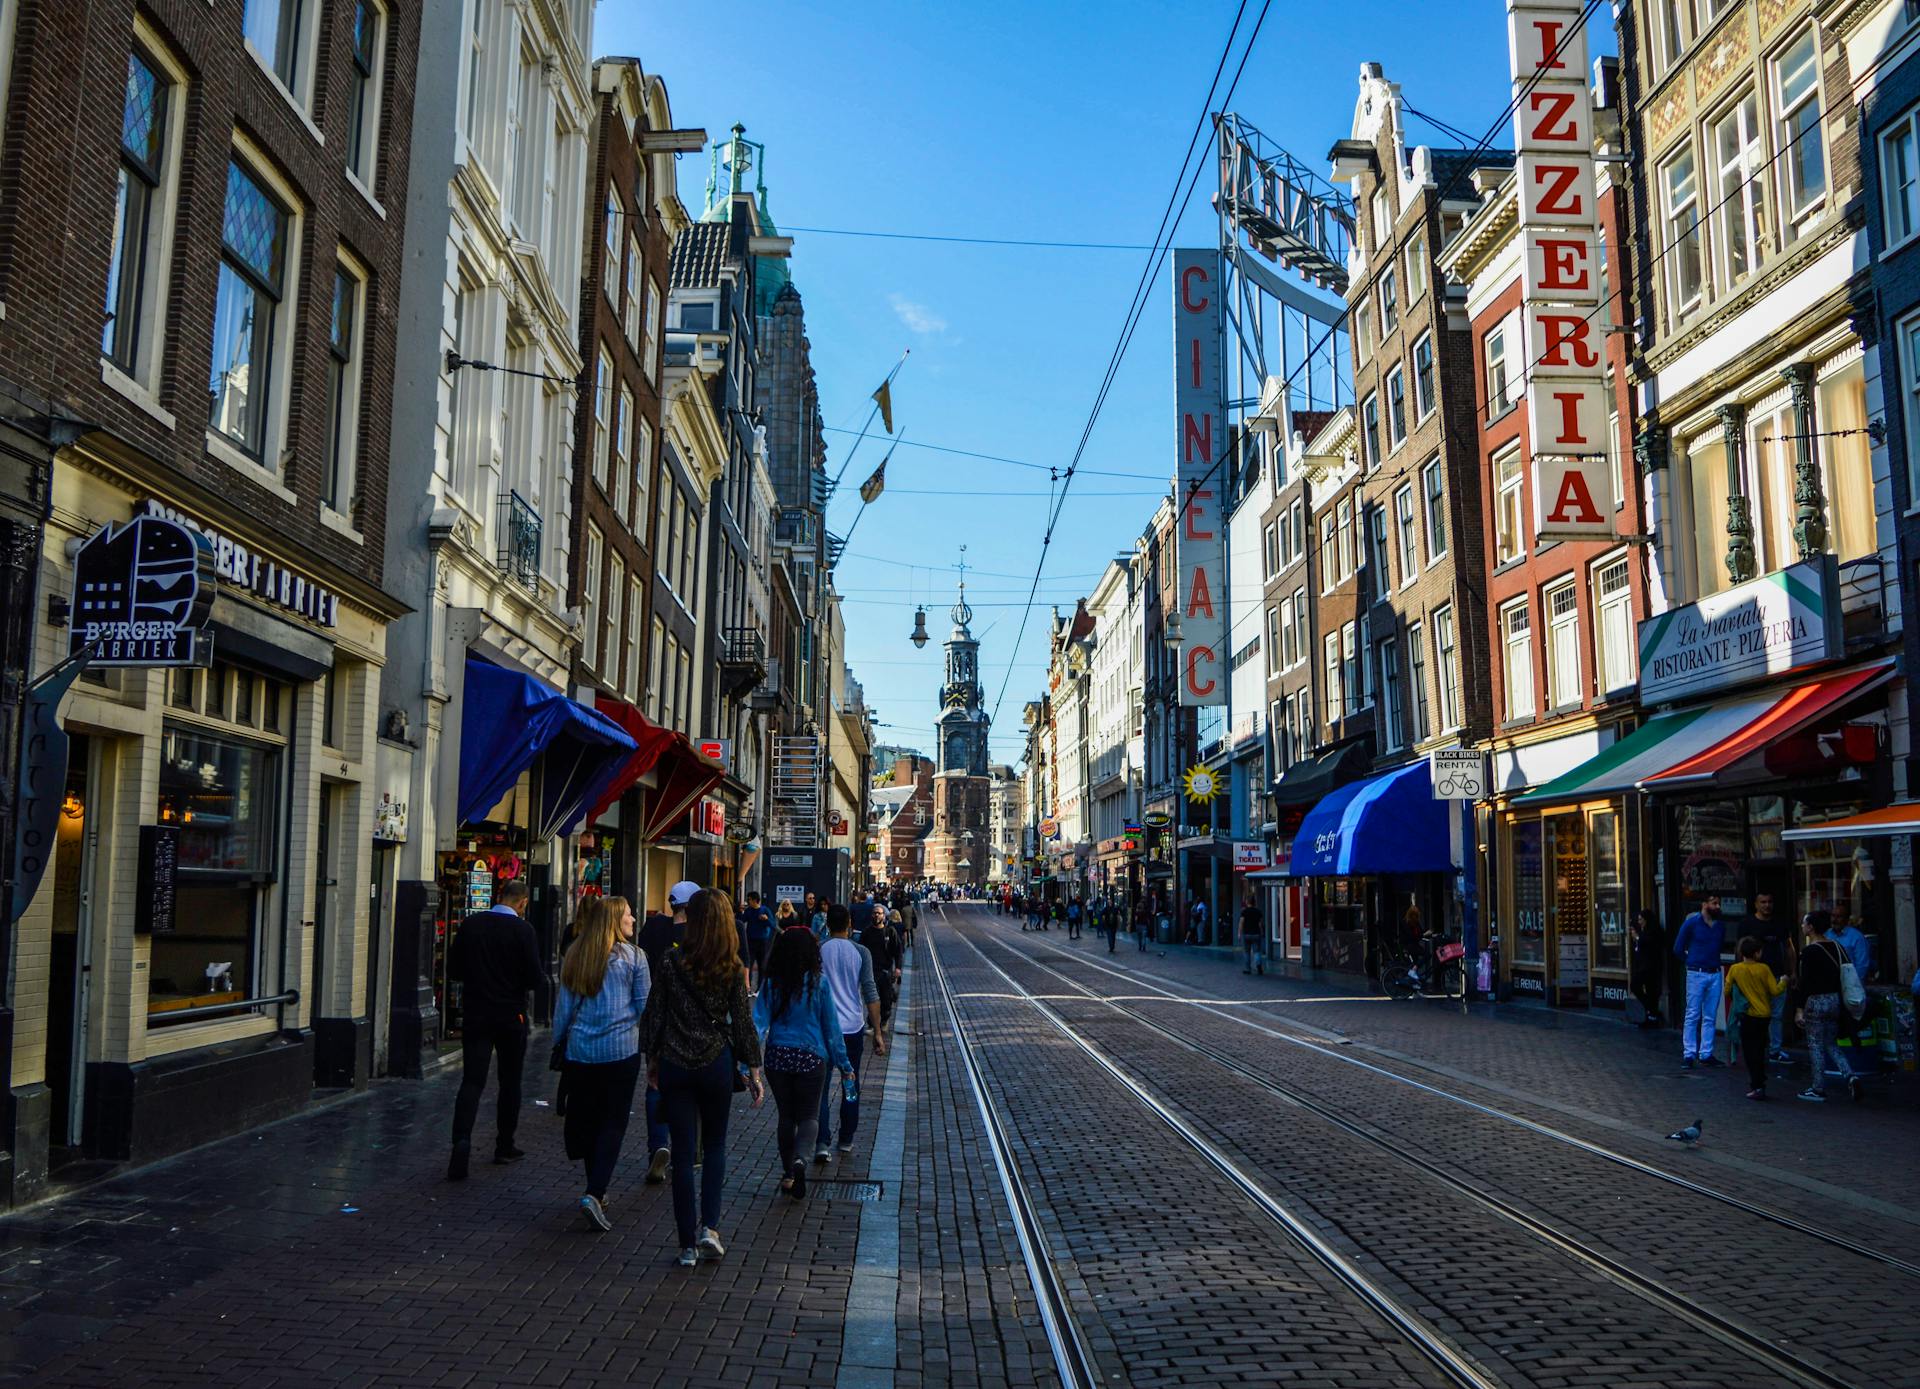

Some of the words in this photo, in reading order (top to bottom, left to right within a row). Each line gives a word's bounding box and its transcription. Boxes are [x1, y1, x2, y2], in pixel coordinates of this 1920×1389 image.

[1530, 20, 1605, 524] IZZERIA
[1180, 265, 1216, 698] CINEAC
[85, 620, 177, 642] BURGER
[1676, 614, 1698, 649] La
[1701, 594, 1767, 640] Traviata
[86, 640, 177, 659] ABRIEK
[1653, 637, 1731, 681] RISTORANTE
[1739, 615, 1808, 656] PIZZERIA
[1435, 751, 1458, 759] BLACK
[1458, 751, 1480, 759] BIKES
[1436, 761, 1480, 769] RENTAL
[339, 763, 348, 776] 44
[21, 702, 48, 875] TATTOO
[1518, 911, 1544, 931] SALE
[1600, 911, 1625, 933] SAL
[1520, 978, 1544, 992] RENTAL
[1603, 986, 1629, 1000] RENTA
